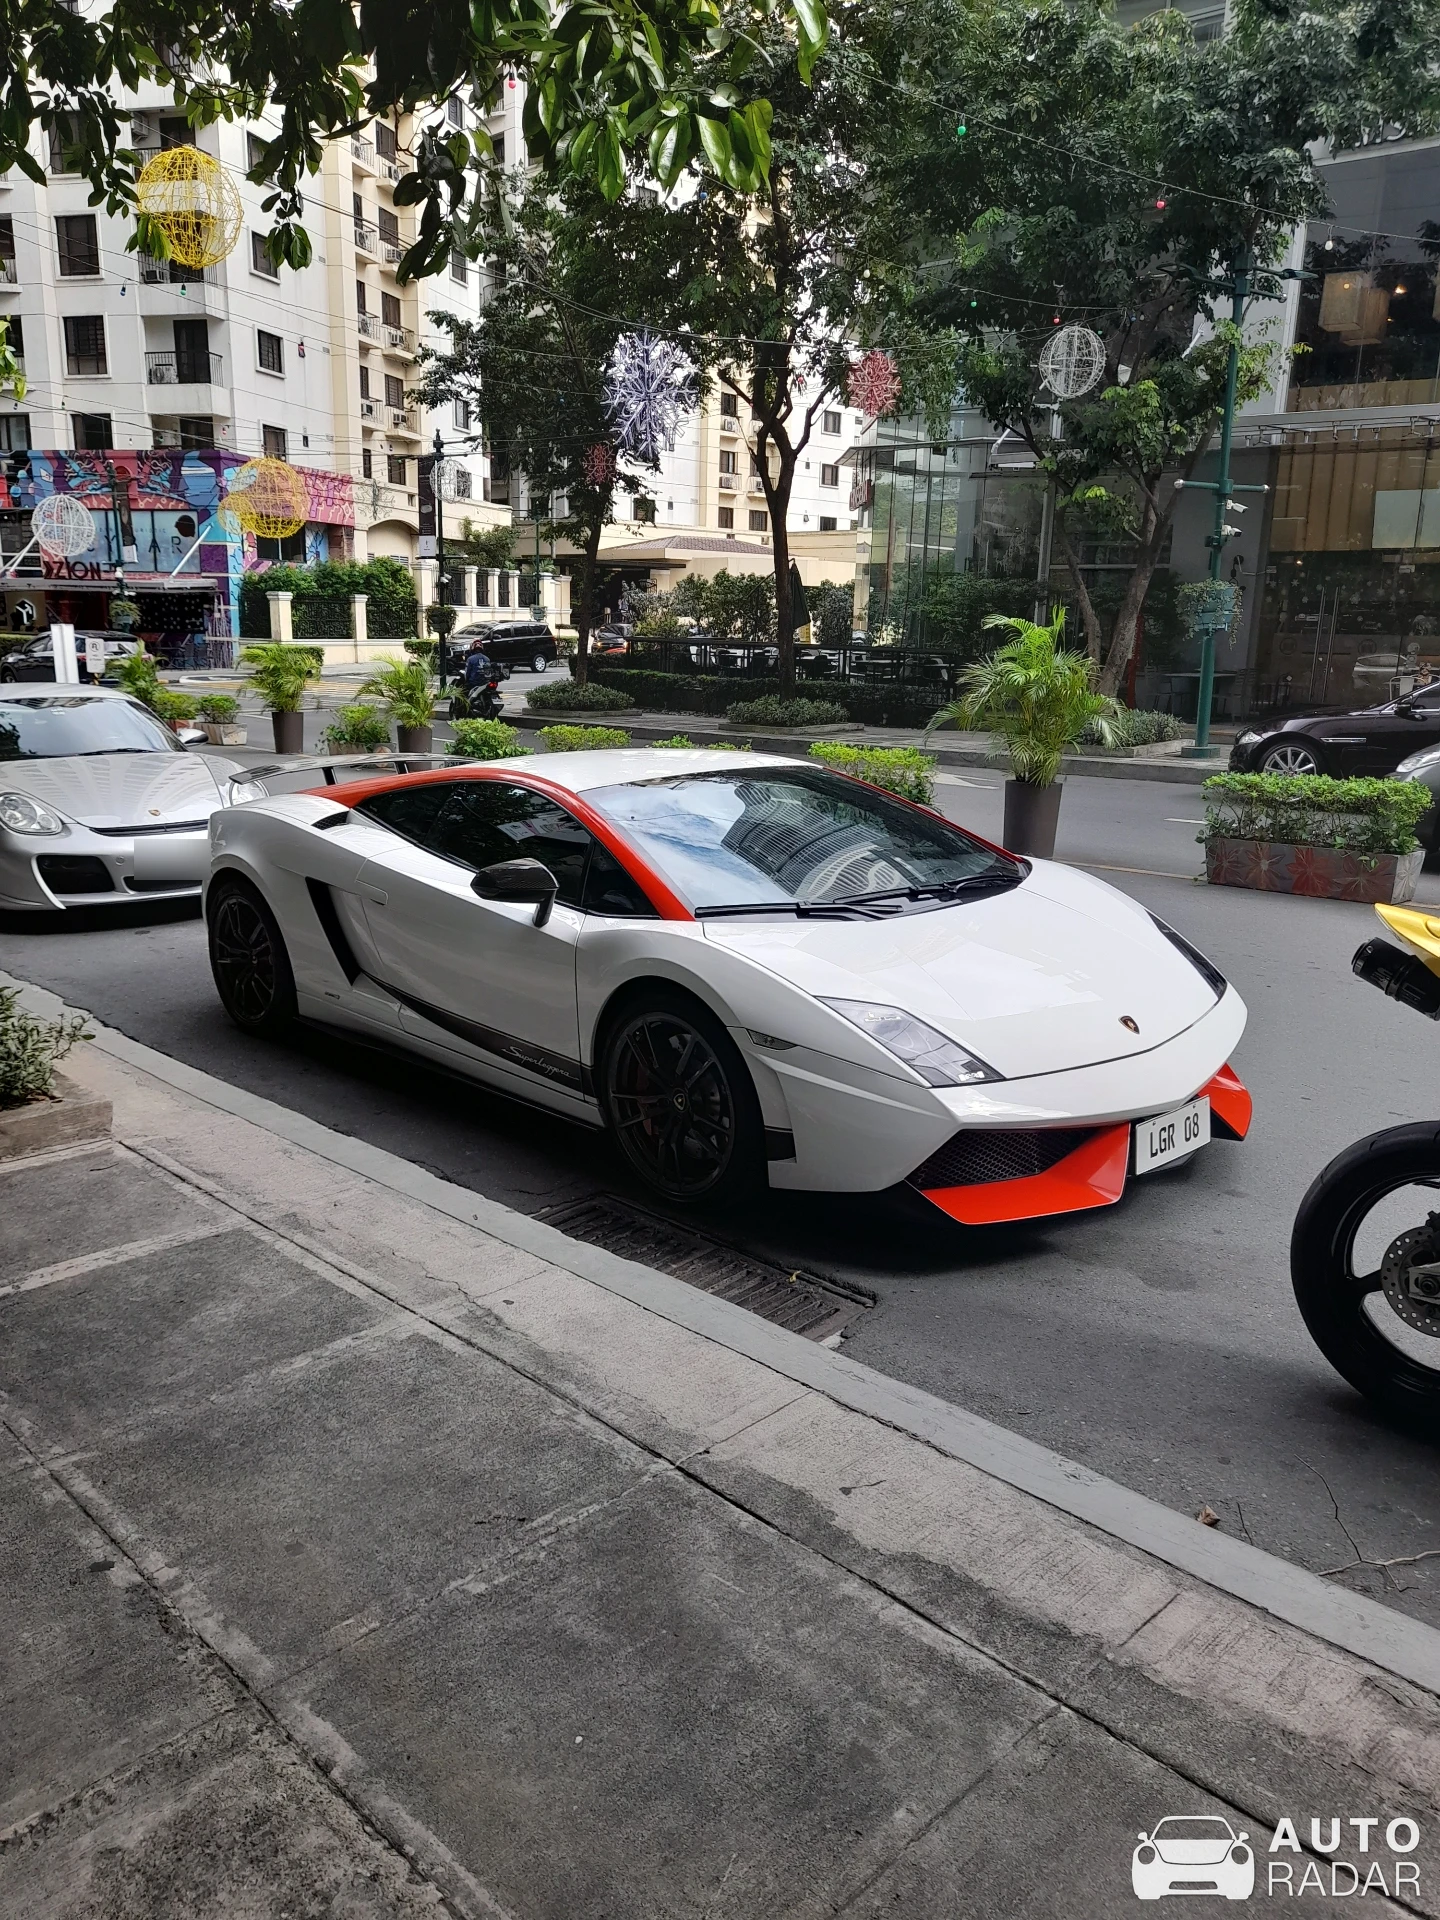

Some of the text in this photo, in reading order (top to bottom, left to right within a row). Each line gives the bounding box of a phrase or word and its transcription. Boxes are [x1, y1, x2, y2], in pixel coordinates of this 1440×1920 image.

[501, 1046, 580, 1081] Superleggera
[1150, 1112, 1199, 1158] LGR 08
